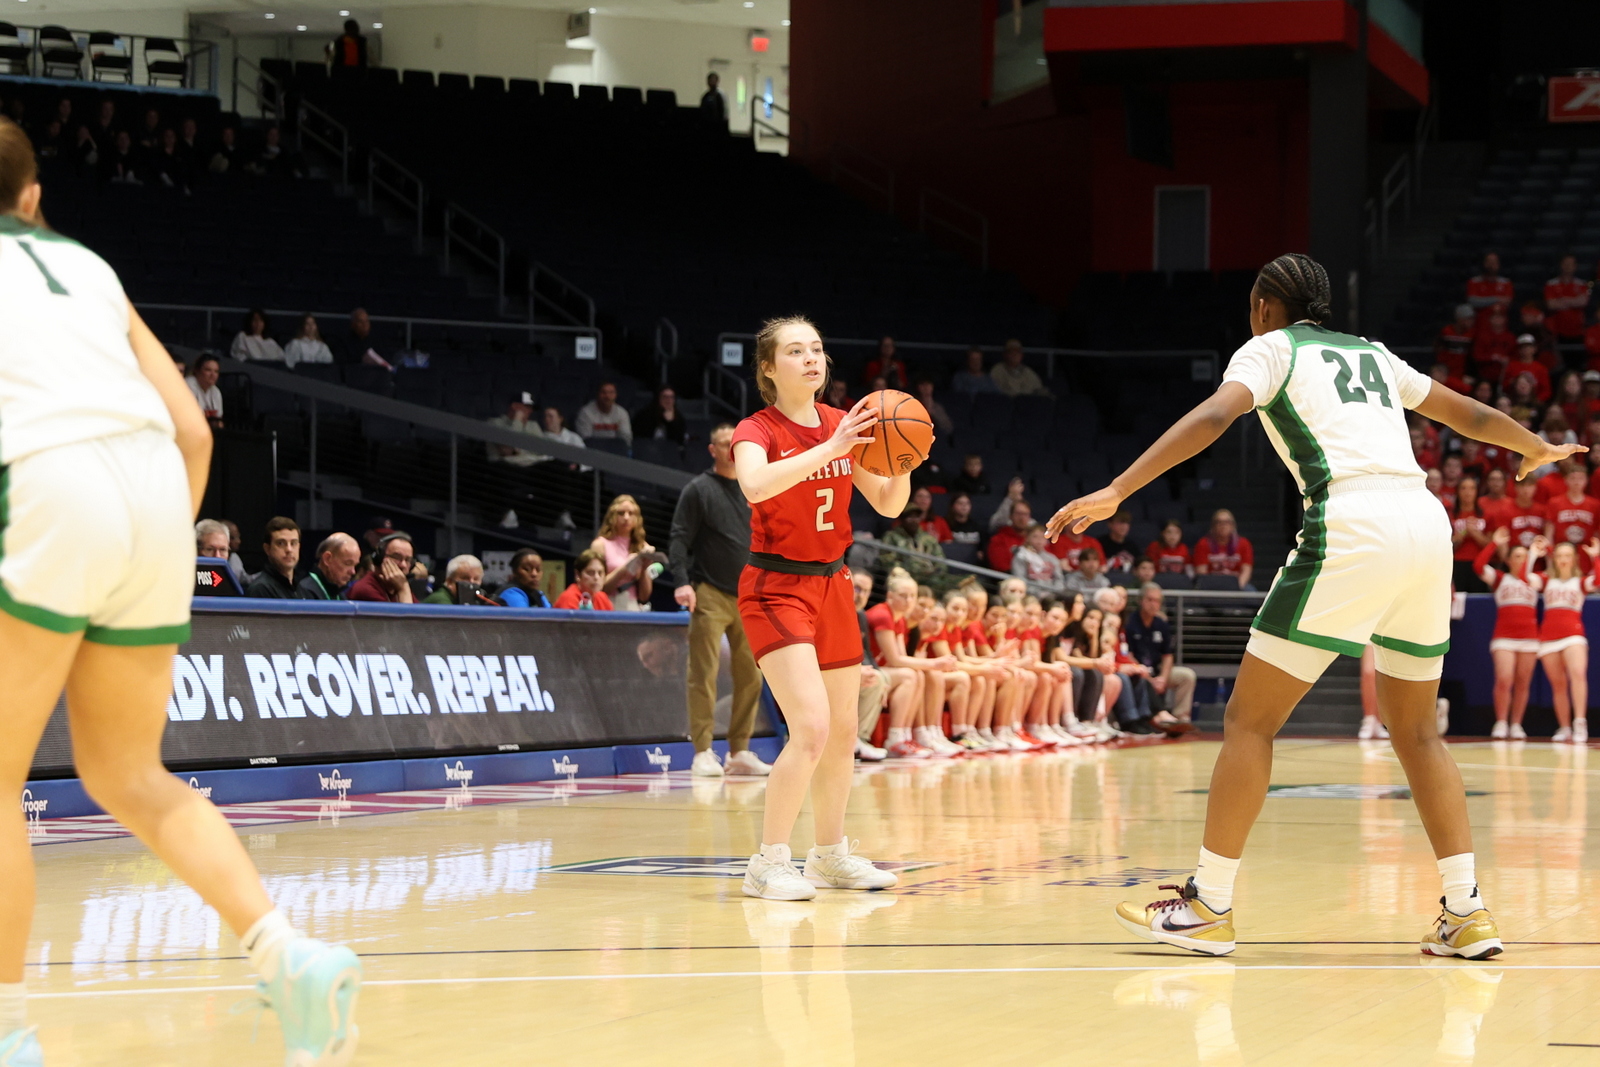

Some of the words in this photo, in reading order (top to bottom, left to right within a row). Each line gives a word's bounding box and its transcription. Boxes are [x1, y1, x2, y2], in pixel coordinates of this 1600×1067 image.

[18, 240, 71, 297] 1
[1320, 349, 1394, 410] 24
[815, 488, 835, 532] 2
[196, 571, 213, 585] POSS
[243, 653, 432, 719] RECOVER.
[425, 655, 556, 713] REPEAT.
[330, 769, 352, 797] Kroger
